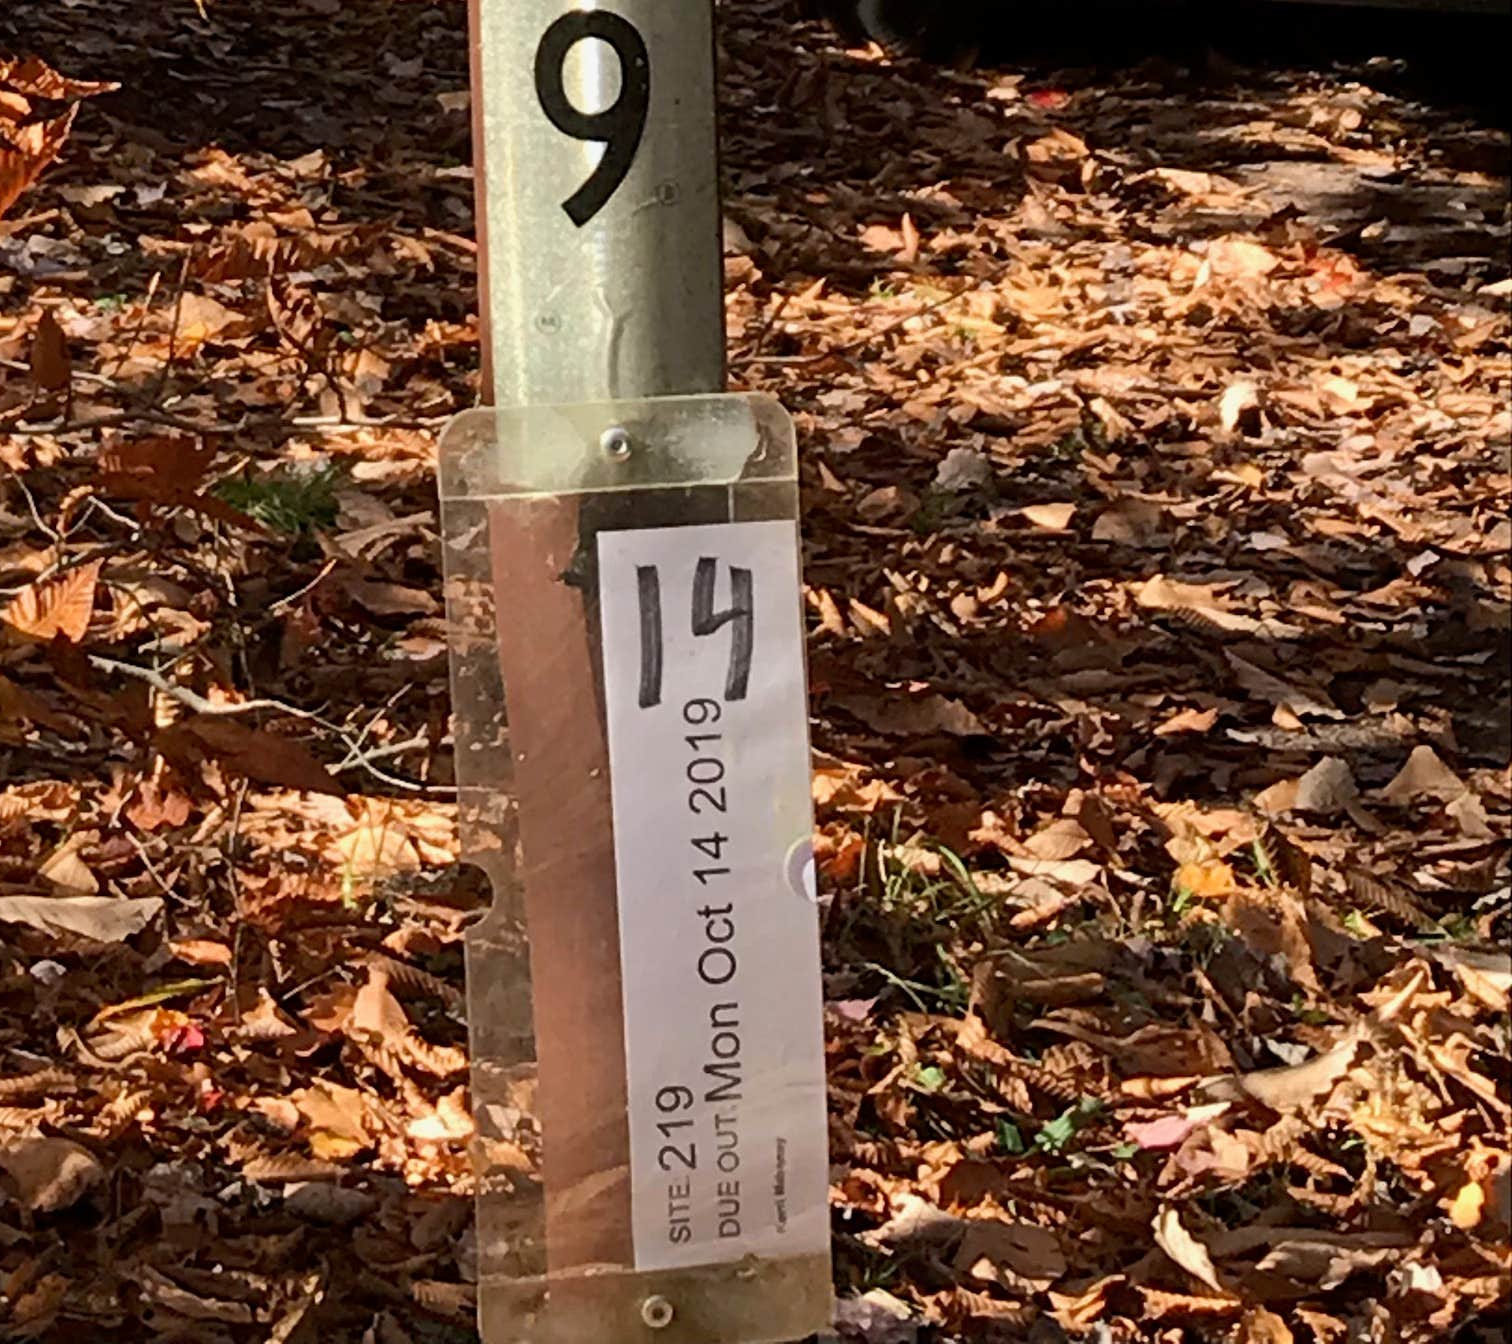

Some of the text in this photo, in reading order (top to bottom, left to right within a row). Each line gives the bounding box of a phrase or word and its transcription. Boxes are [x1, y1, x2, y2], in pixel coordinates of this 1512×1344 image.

[637, 557, 753, 708] 14
[683, 698, 727, 813] 2019
[690, 831, 731, 885] 14
[696, 902, 737, 985] Oct
[702, 1002, 742, 1102] Mon
[655, 1086, 697, 1171] 219
[718, 1180, 741, 1238] DUE
